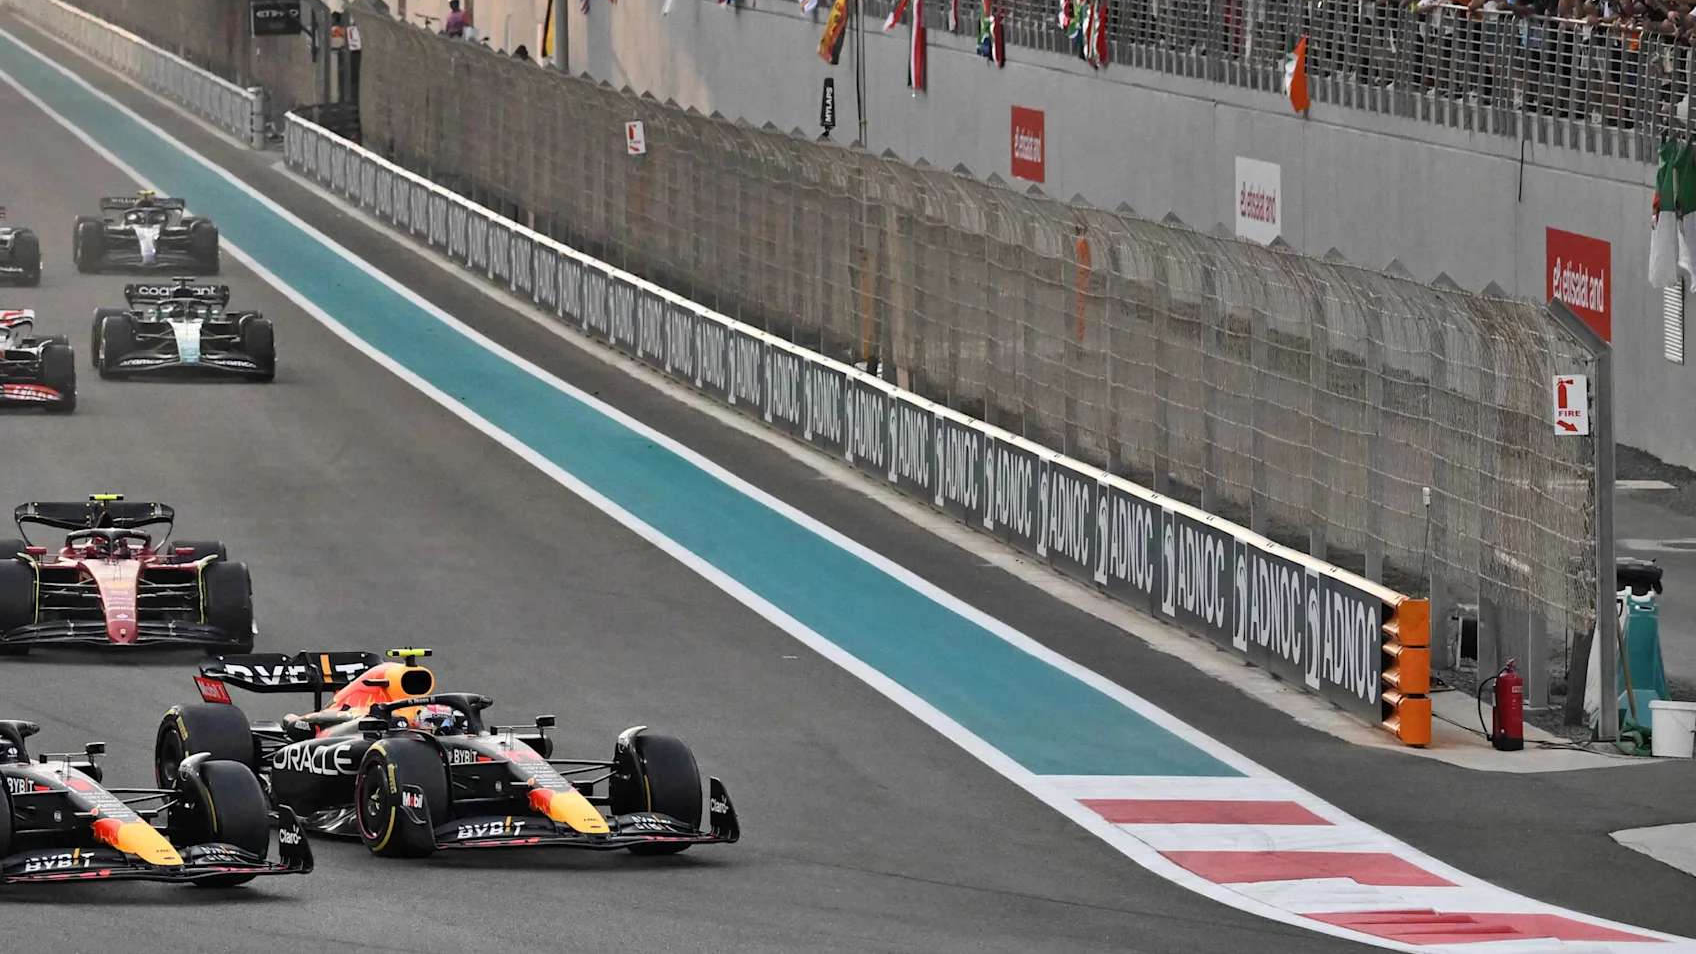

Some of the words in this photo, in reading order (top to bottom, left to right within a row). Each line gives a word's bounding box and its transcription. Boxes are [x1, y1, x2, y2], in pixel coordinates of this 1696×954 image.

[825, 86, 835, 123] MYLAPS
[1563, 260, 1589, 310] etisalat
[1590, 268, 1604, 313] and
[771, 351, 800, 425] ADNOC
[811, 368, 841, 444] ADNOC
[853, 389, 884, 468] ADNOC
[897, 406, 929, 488] ADNOC
[944, 427, 979, 510] ADNOC
[995, 447, 1033, 538] ADNOC
[1048, 470, 1090, 567] ADNOC
[1109, 497, 1154, 594] ADNOC
[1177, 523, 1225, 630] ADNOC
[1250, 553, 1302, 666] ADNOC
[1322, 589, 1378, 705] ADNOC
[273, 744, 358, 775] ORACLE
[454, 749, 478, 763] BYBIT
[7, 776, 34, 792] BYBIT
[403, 791, 423, 809] Mobil
[279, 826, 301, 845] Claro
[457, 816, 525, 839] BYBIT
[24, 848, 94, 872] BYBIT
